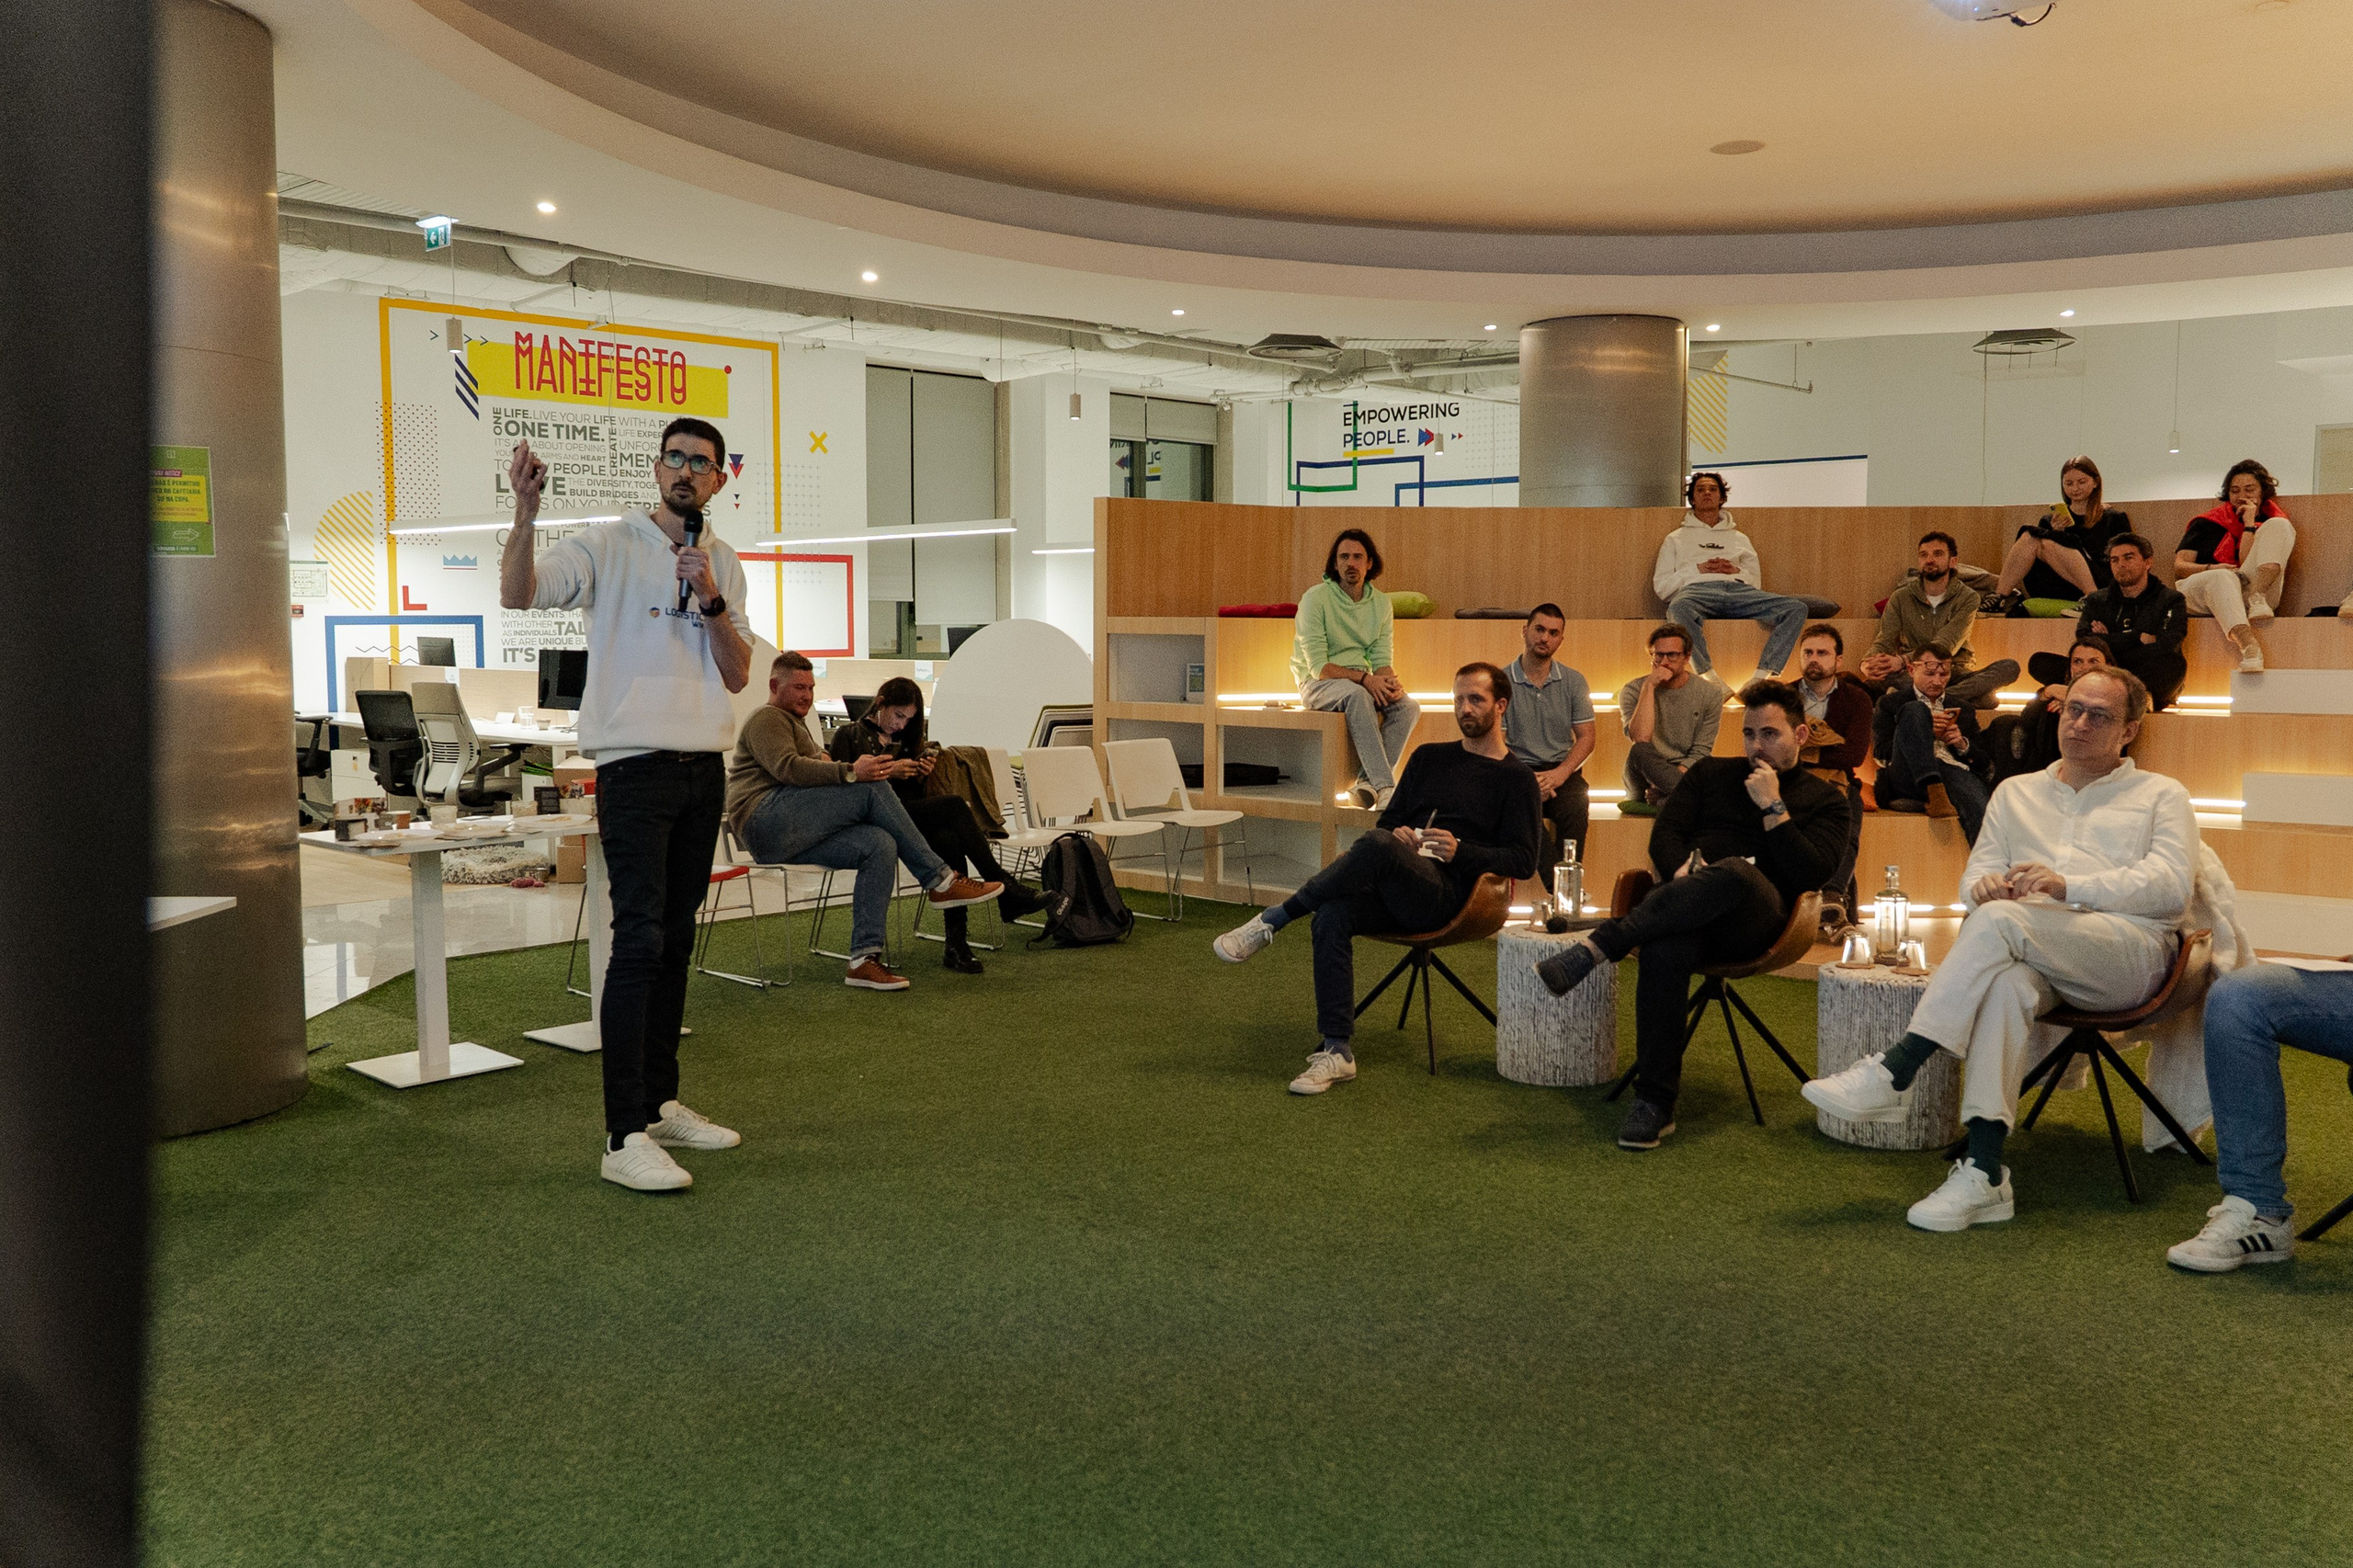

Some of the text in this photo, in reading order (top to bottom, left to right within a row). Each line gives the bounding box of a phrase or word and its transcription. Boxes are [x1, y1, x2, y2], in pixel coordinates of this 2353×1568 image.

[515, 331, 688, 405] MANIFESTO
[493, 406, 502, 436] ONE
[504, 408, 532, 419] LIFE.
[533, 410, 557, 422] LIVE
[559, 412, 591, 424] YOUR
[594, 415, 617, 426] LIFE
[618, 416, 647, 427] WITH
[649, 419, 657, 428] A
[1343, 402, 1461, 426] EMPOWERING
[506, 420, 606, 442] ONE TIME.
[619, 429, 664, 439] LIFE EXPER
[1343, 428, 1410, 448] PEOPLE.
[532, 440, 563, 451] ABOUT
[565, 443, 607, 453] OPENING
[608, 427, 619, 477] CREATE
[540, 452, 563, 460] ARMS
[563, 453, 579, 461] AND
[620, 453, 660, 469] MEM
[620, 470, 652, 479] ENJOY
[495, 473, 566, 496] LVE
[568, 477, 585, 487] THE
[634, 481, 658, 490] TOGE
[569, 488, 597, 497] BUILD
[599, 489, 639, 499] BRIDGES
[501, 610, 509, 619] IN
[512, 610, 529, 619] OUR
[568, 610, 584, 619] THA
[665, 607, 707, 622] LOGISTIC
[501, 619, 524, 628] WITH
[554, 620, 585, 636] TAL
[501, 638, 517, 646] WE
[518, 638, 537, 646] ARE
[539, 637, 574, 645] UNIQUE
[503, 647, 536, 664] IT'S
